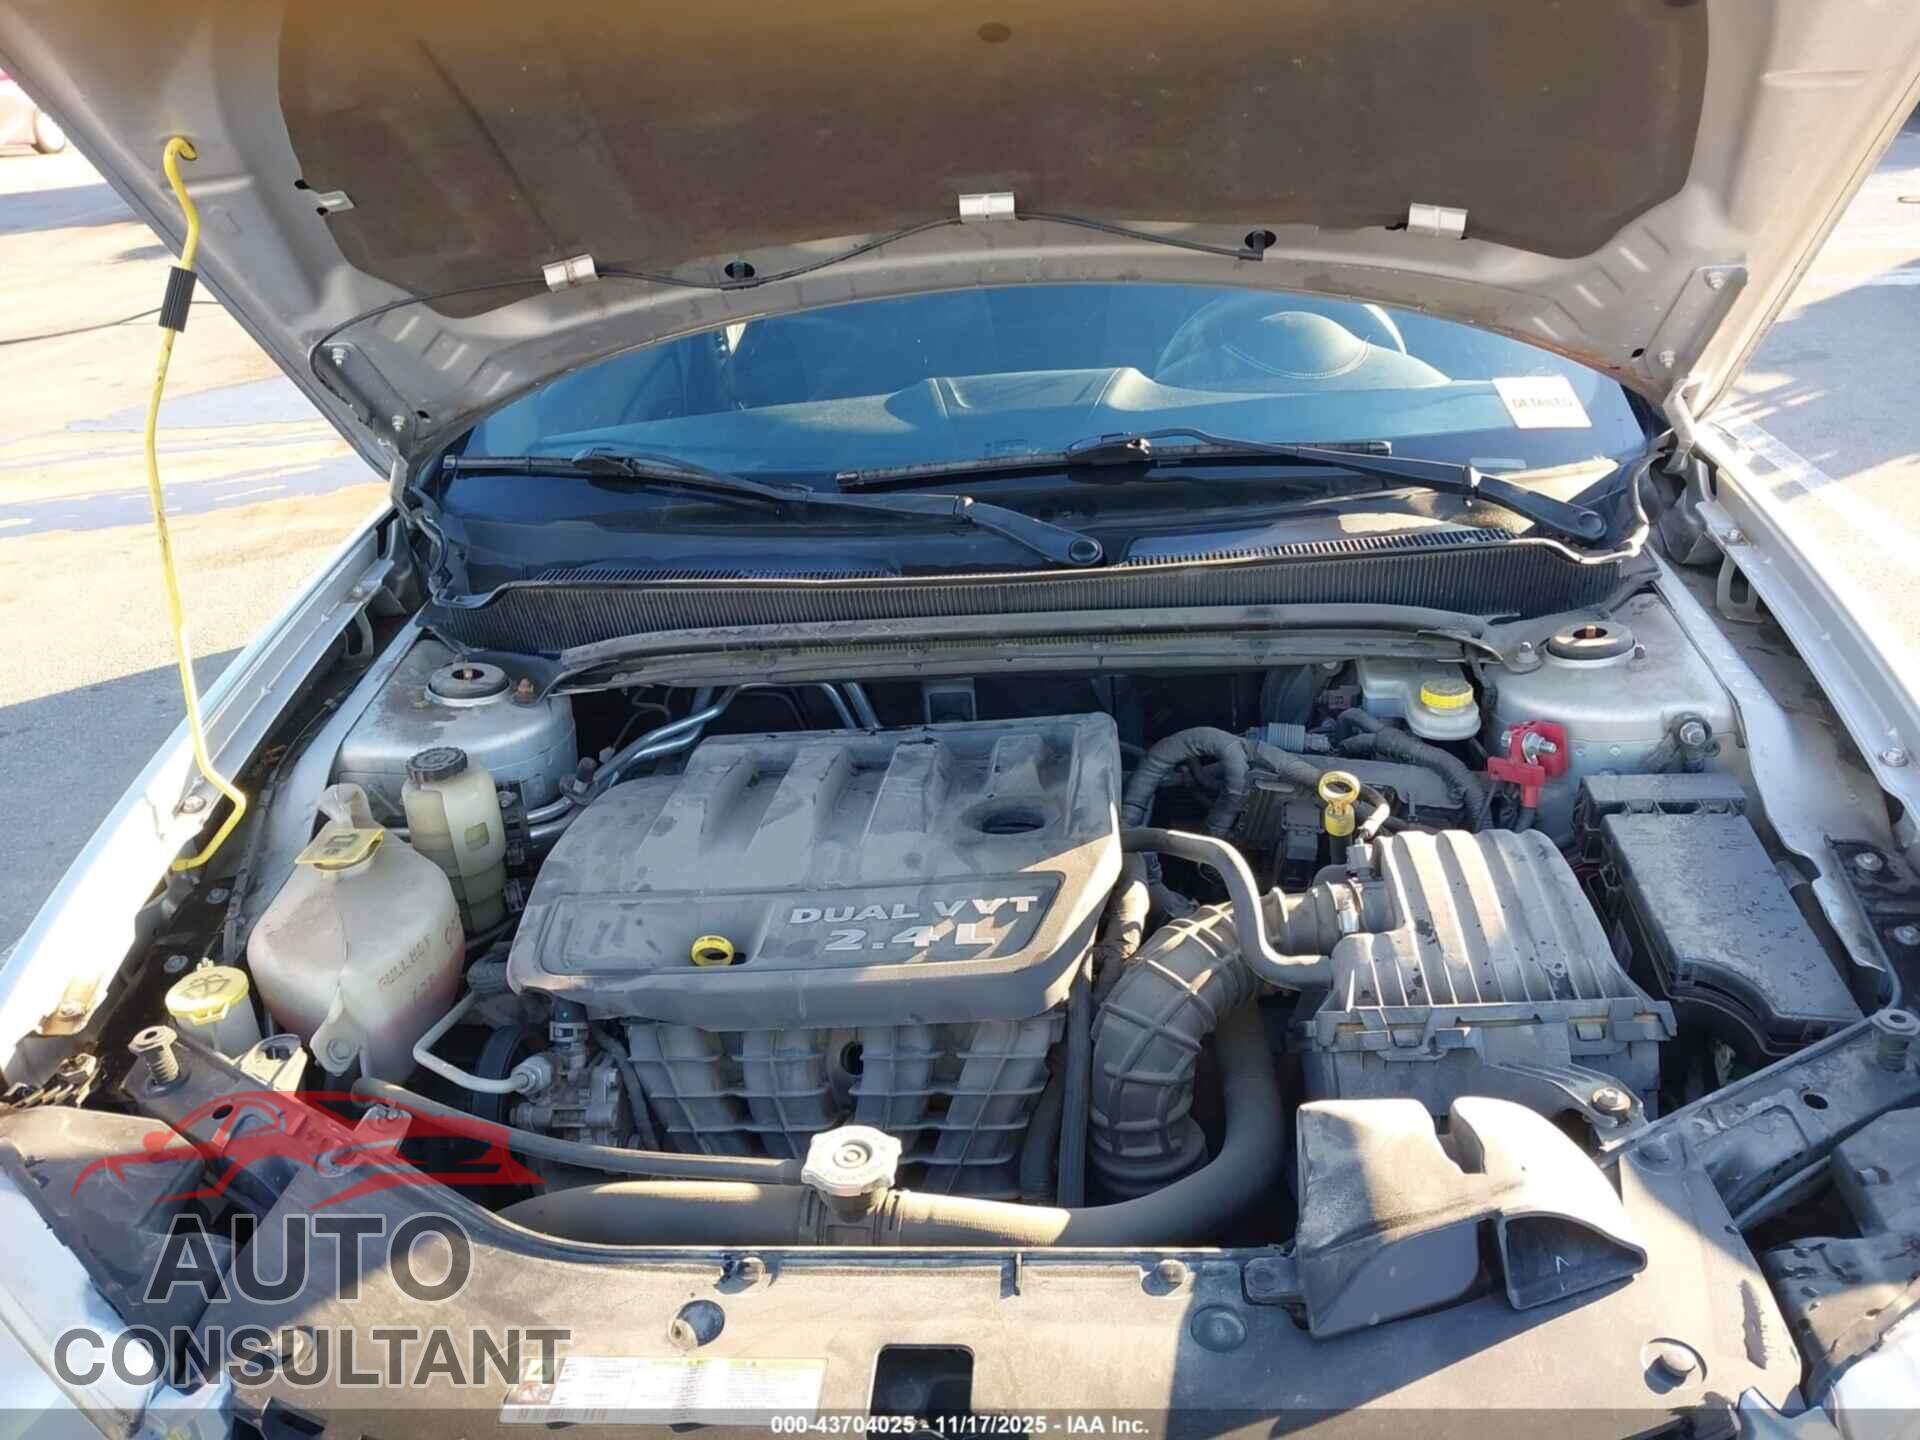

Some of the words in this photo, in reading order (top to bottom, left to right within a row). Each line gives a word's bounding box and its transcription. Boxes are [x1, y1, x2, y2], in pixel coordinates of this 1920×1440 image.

[789, 903, 920, 924] DUAL
[932, 896, 1039, 917] VVT
[823, 922, 996, 951] 2.4L
